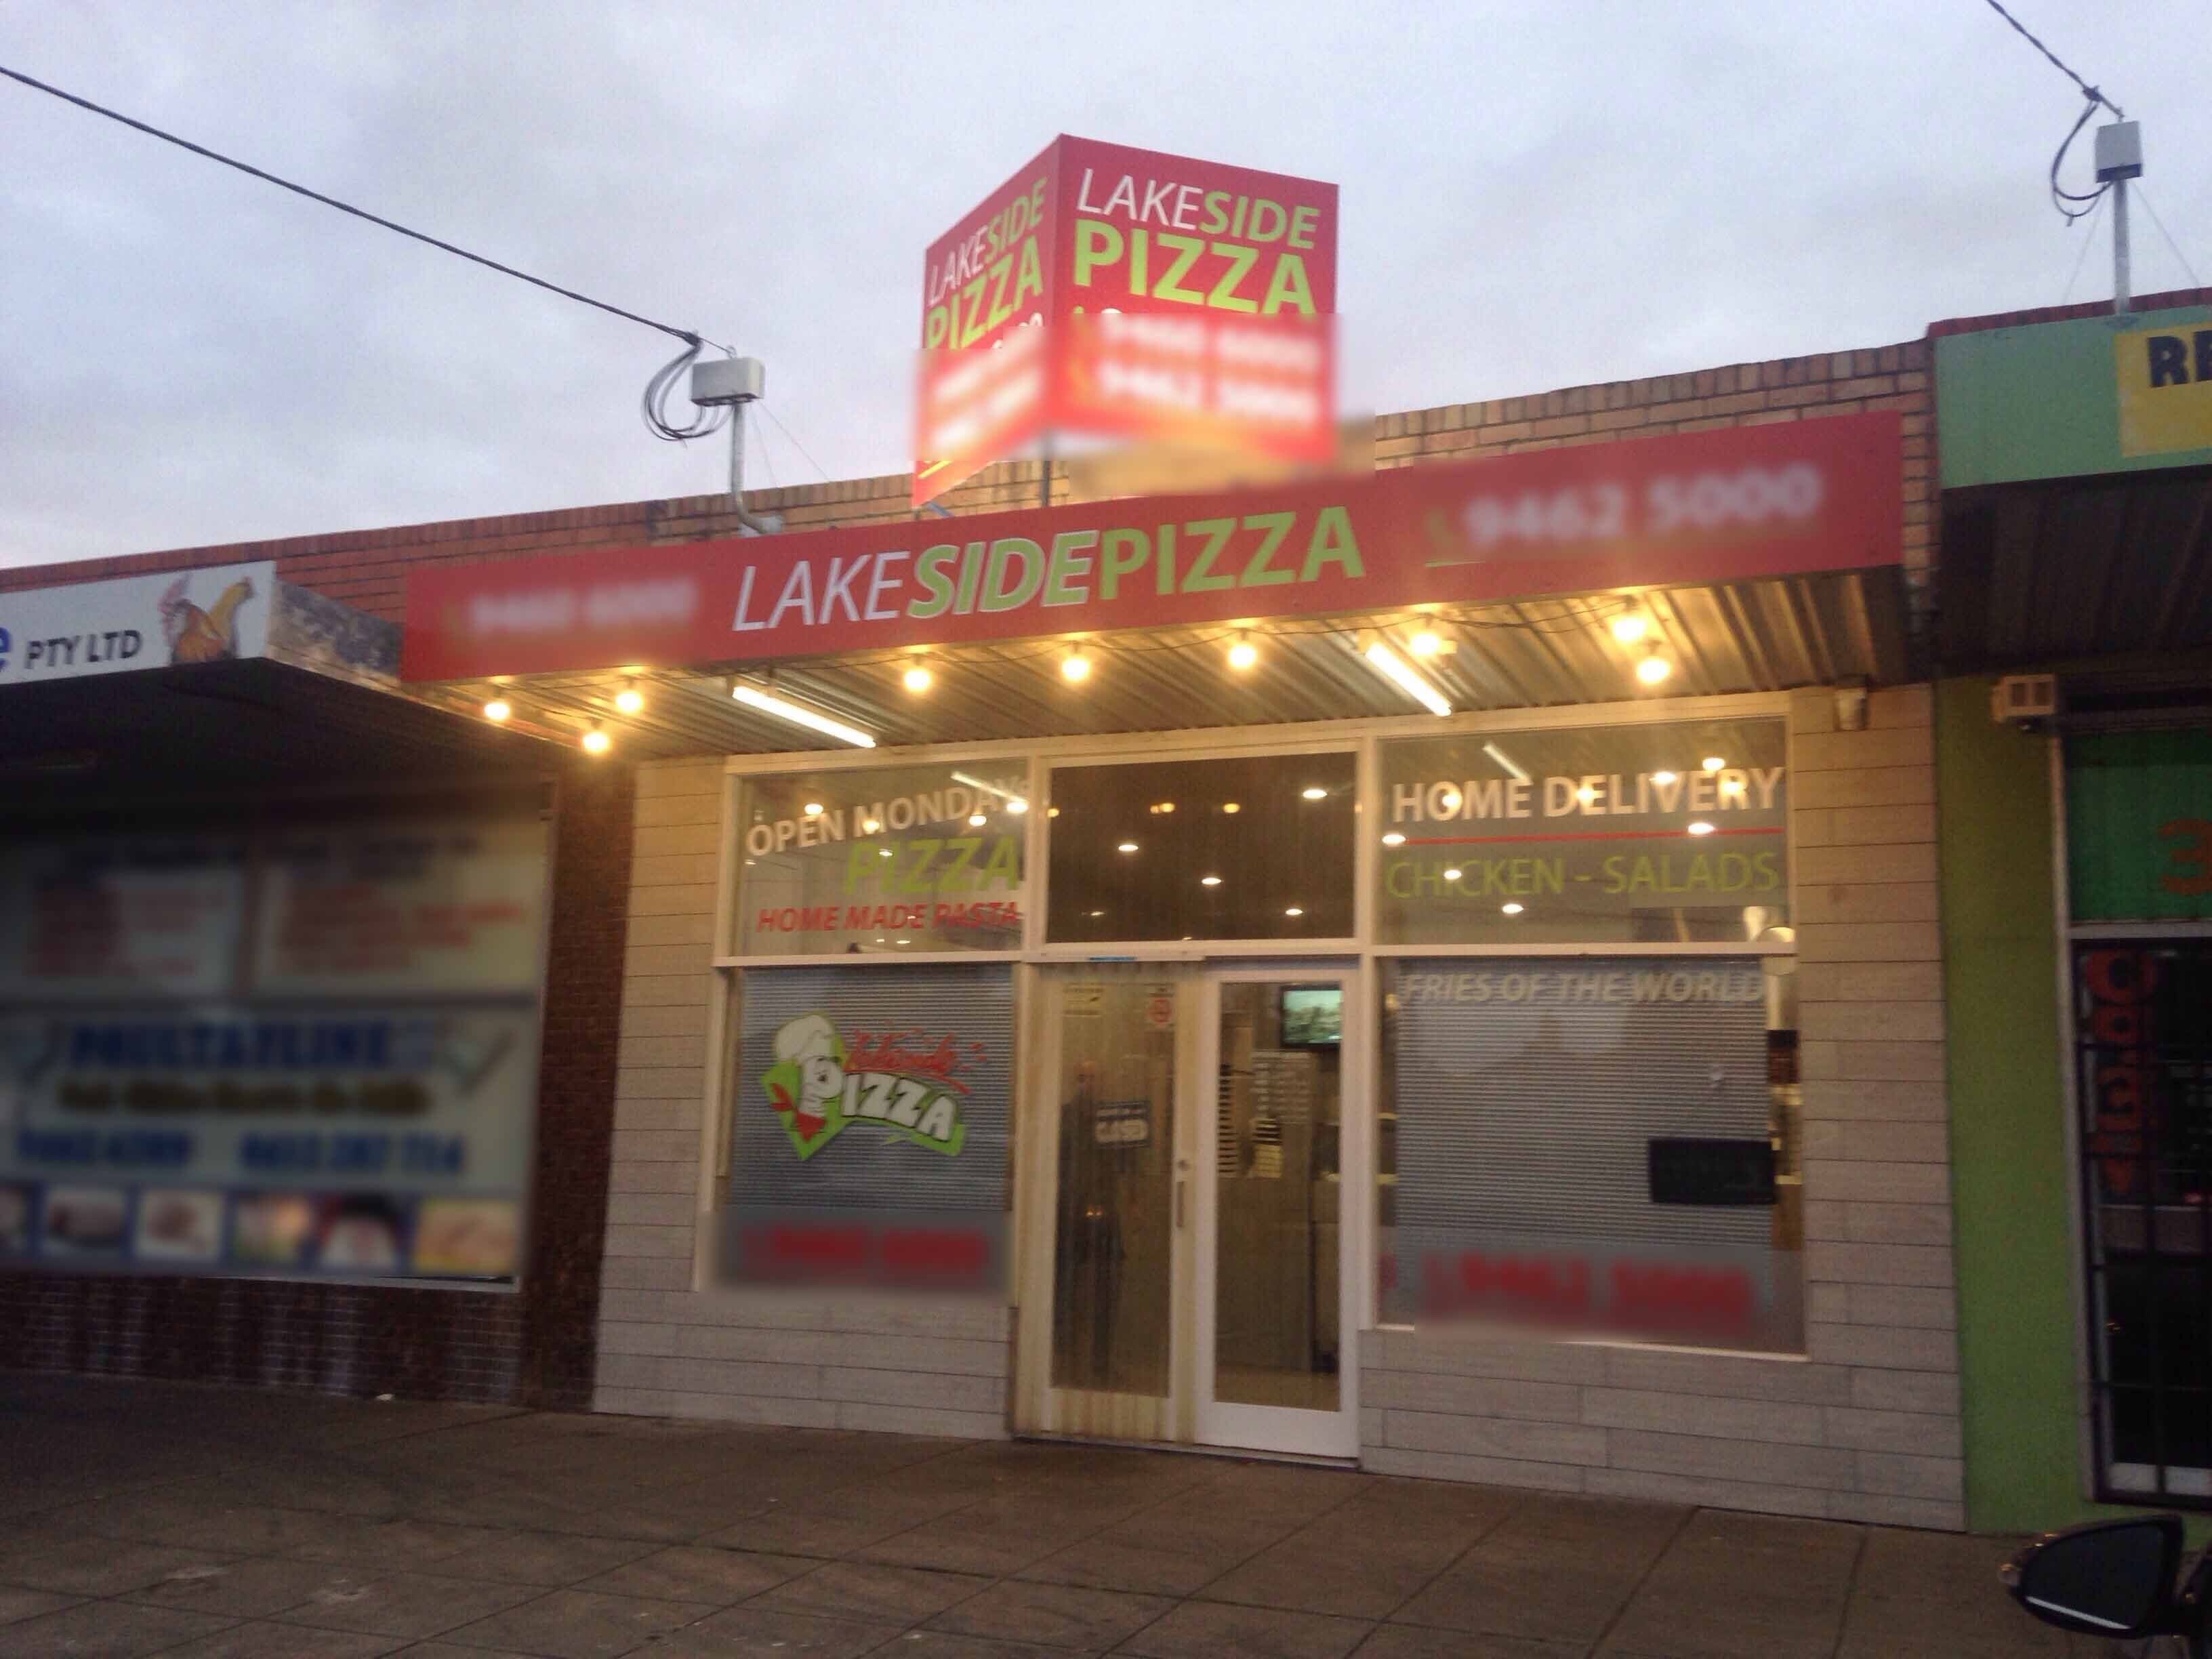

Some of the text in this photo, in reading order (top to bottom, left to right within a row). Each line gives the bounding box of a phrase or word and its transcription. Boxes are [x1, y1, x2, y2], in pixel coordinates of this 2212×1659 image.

[1076, 167, 1321, 249] LAKESIDE
[928, 176, 1047, 308] LAKESIDE
[926, 234, 1044, 350] PIZZA
[1073, 218, 1317, 324] PIZZA
[24, 636, 81, 670] PTY
[86, 629, 142, 663] LTD
[1392, 766, 1785, 823] HOME DELIVERY
[747, 808, 846, 857] OPEN
[843, 835, 1020, 896] PIZZA
[1384, 857, 1562, 898] CHICKEN
[1603, 852, 1779, 894] SALADS
[756, 901, 1018, 933] HOME MADE PASTA
[1502, 974, 1547, 1002] OF
[1559, 972, 1628, 1002] THE
[1633, 972, 1764, 1003] WORLD
